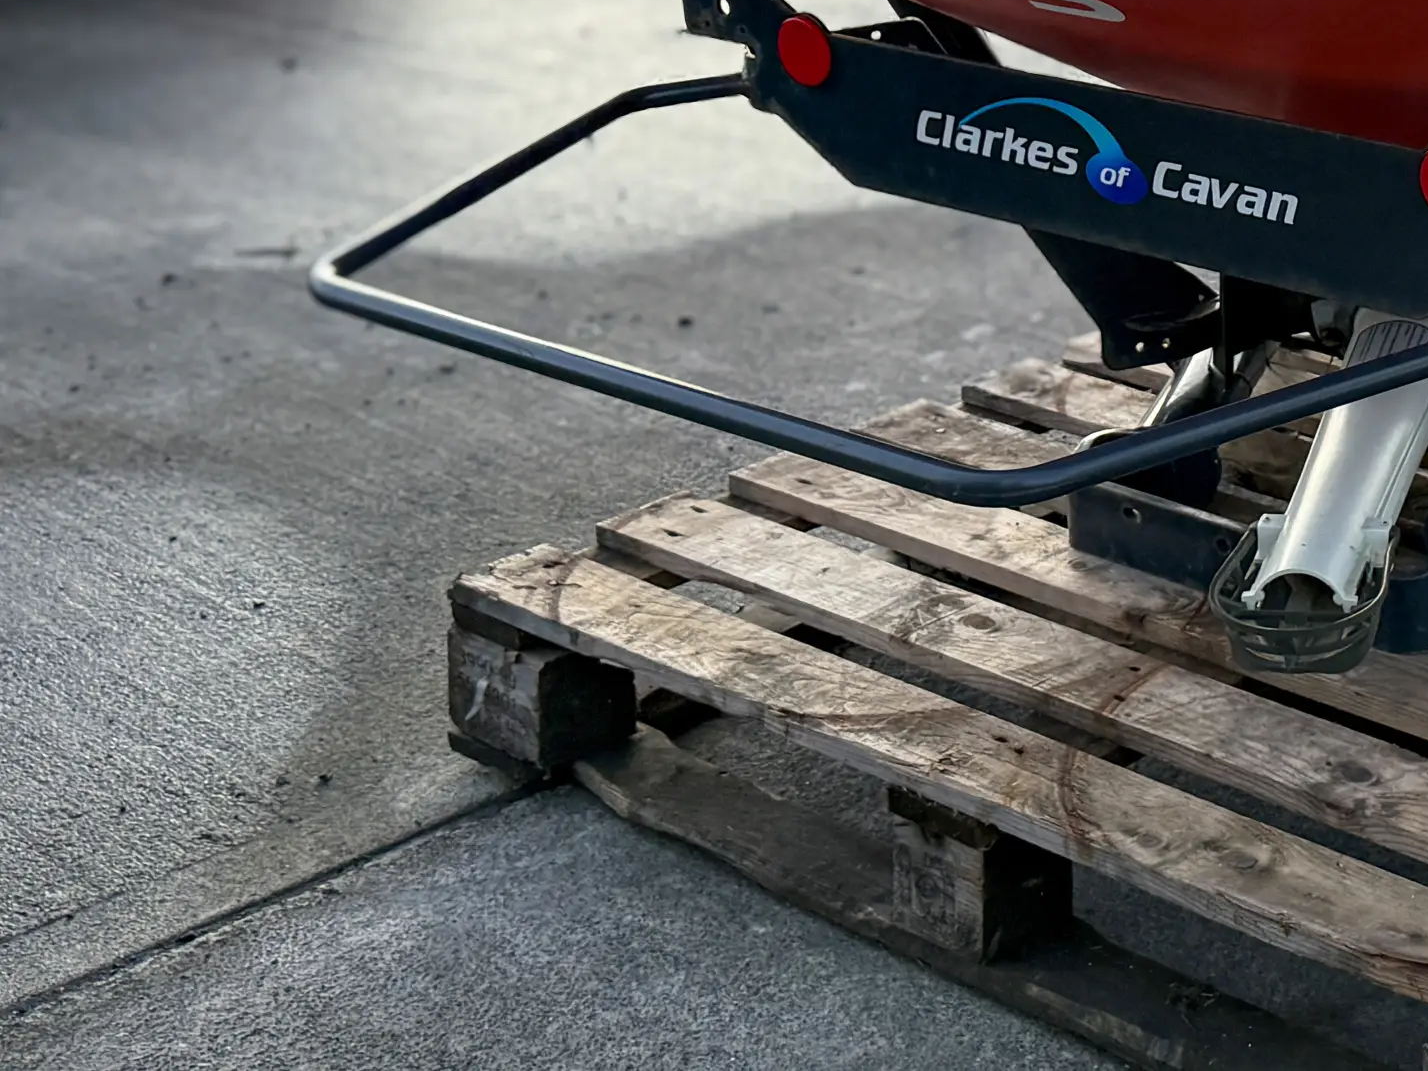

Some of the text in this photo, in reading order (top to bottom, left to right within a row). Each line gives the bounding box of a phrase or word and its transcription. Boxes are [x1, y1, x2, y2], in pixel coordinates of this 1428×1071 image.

[915, 109, 1299, 226] Clarkes of Cavan
